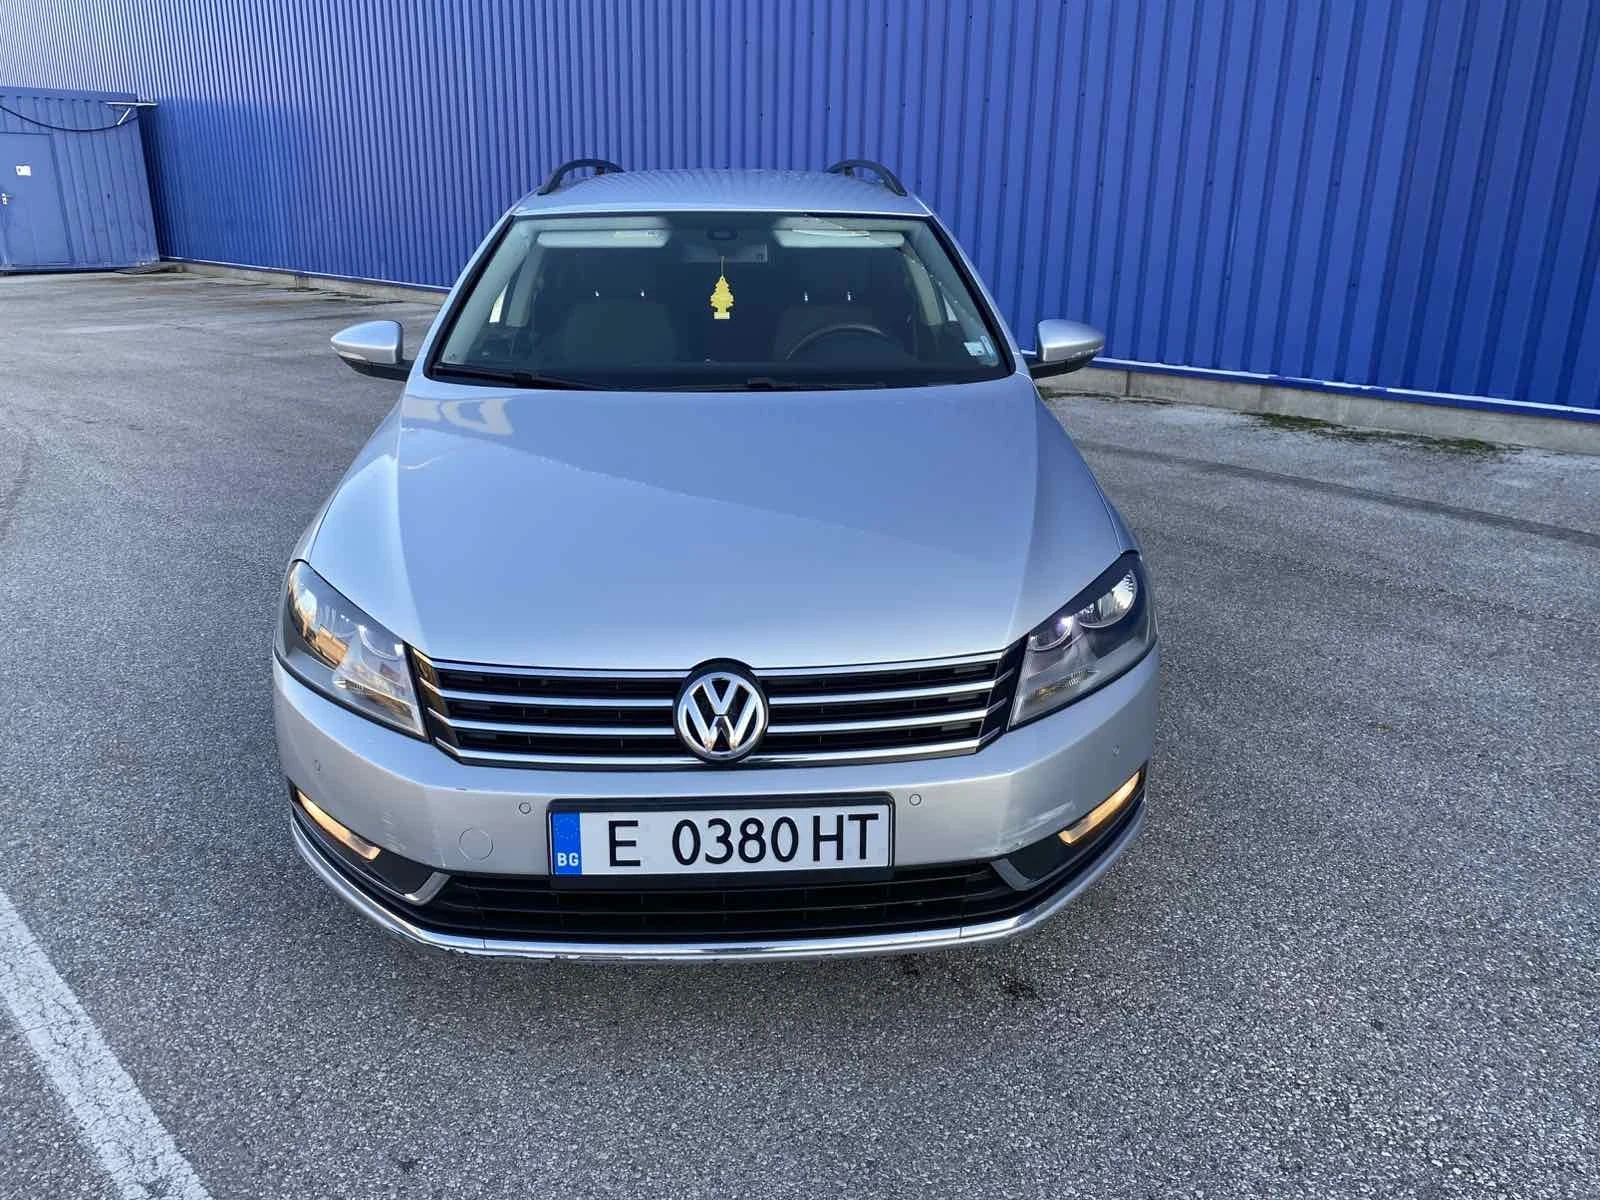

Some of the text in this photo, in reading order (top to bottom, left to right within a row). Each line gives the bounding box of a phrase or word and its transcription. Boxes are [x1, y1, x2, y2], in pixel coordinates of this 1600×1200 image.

[608, 820, 641, 867] E
[672, 816, 799, 866] 0380
[557, 852, 579, 867] BG
